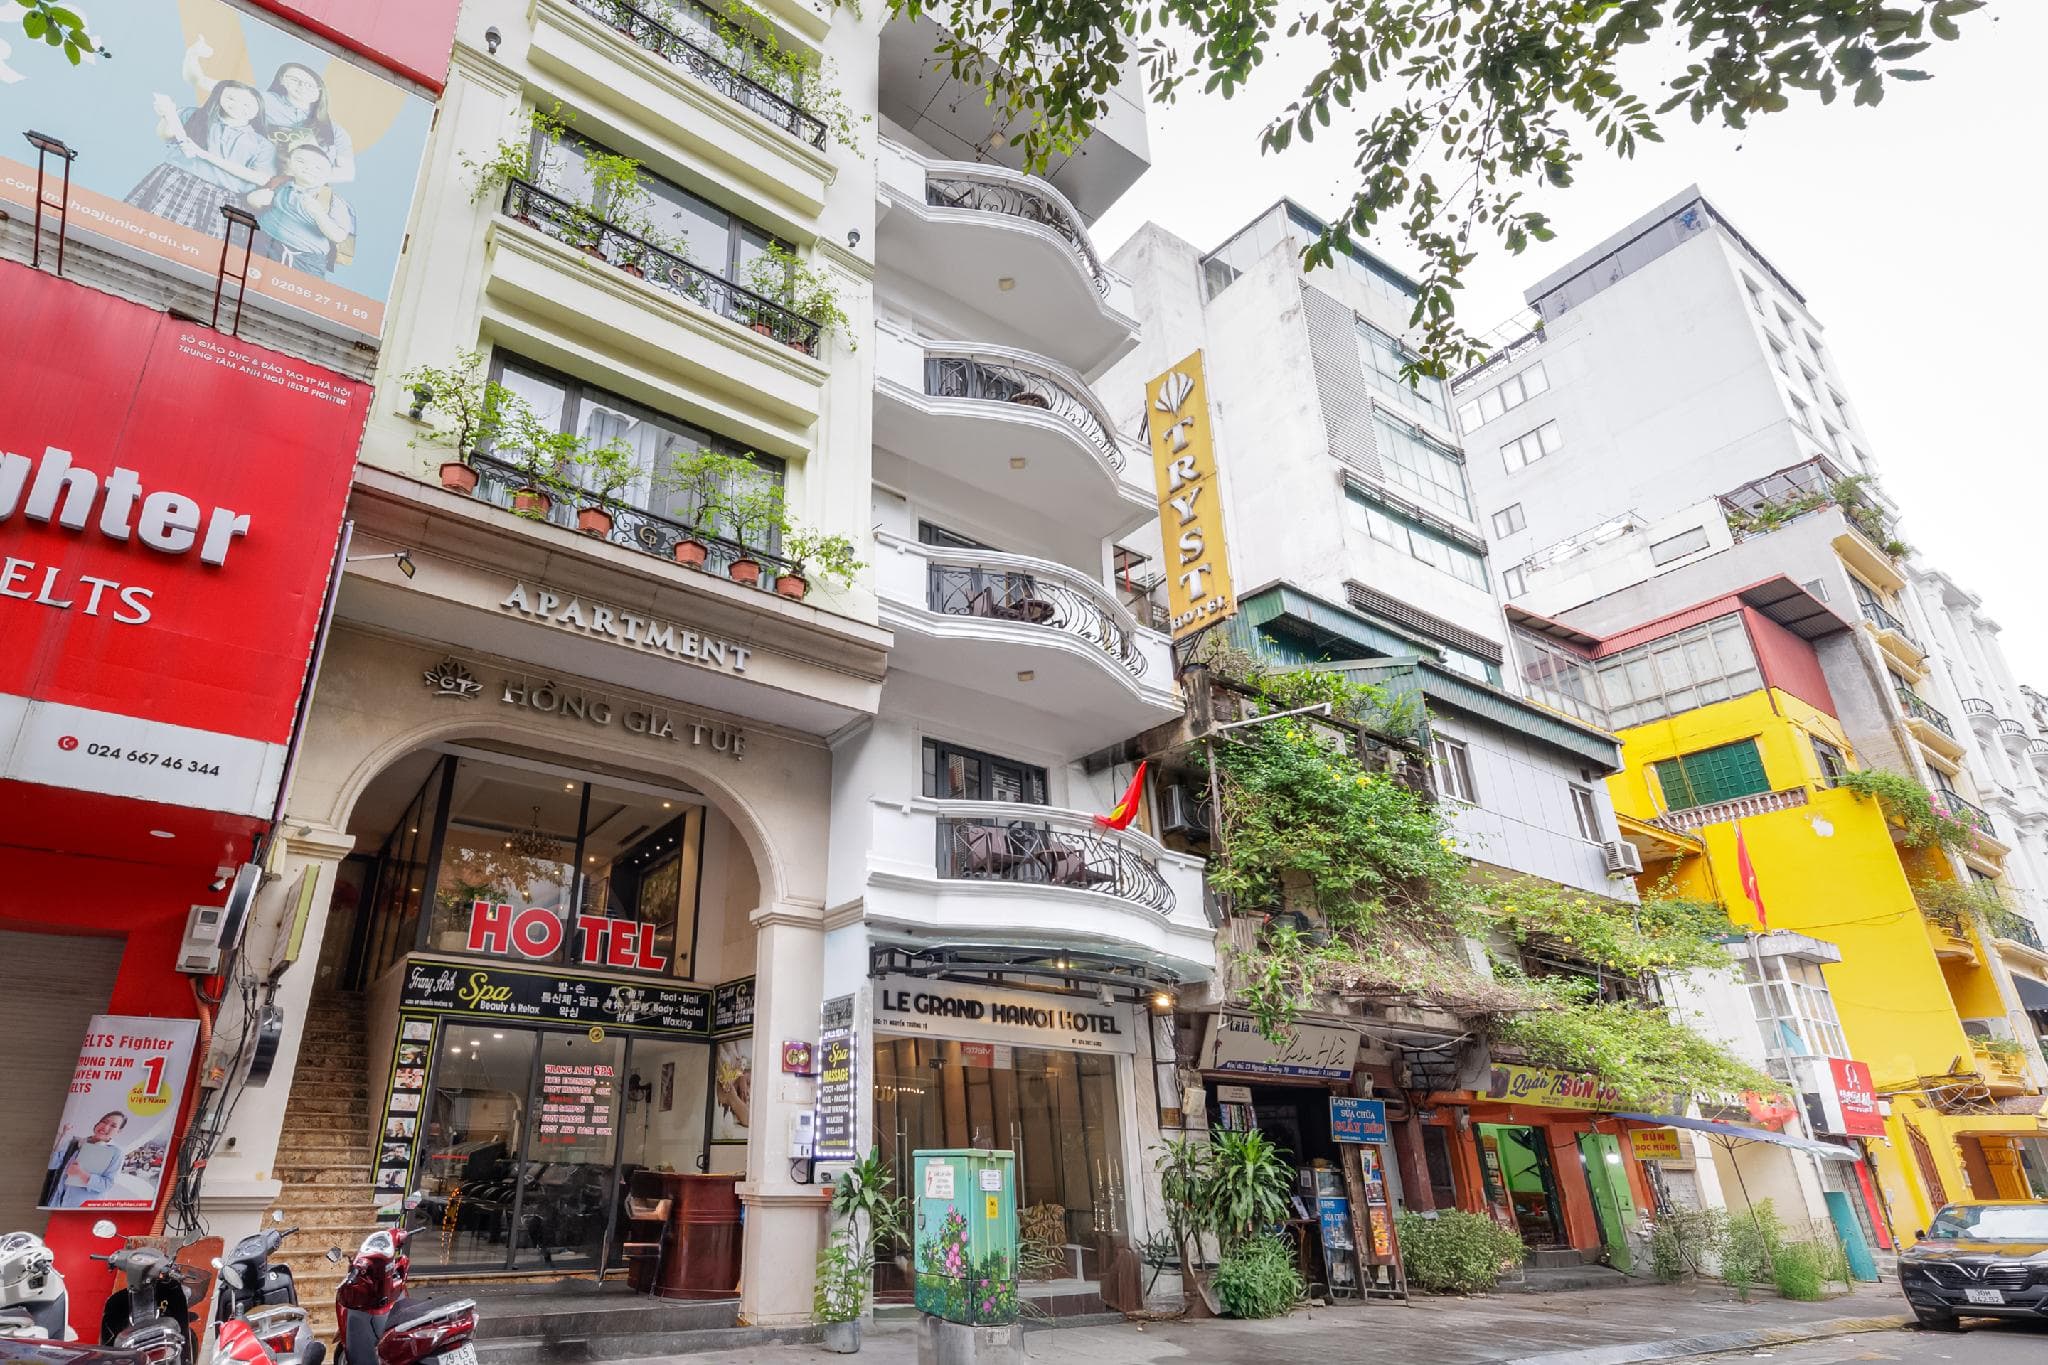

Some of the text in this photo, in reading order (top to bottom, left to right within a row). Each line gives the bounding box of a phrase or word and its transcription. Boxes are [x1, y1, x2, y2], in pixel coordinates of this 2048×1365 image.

[271, 277, 369, 320] 02036 27 11 69
[179, 345, 213, 361] TRUNG
[239, 365, 261, 378] ANH
[288, 381, 309, 393] IELTS
[311, 388, 347, 406] FIGHTER
[306, 376, 317, 385] TP
[1163, 416, 1211, 603] TRYST
[1172, 596, 1229, 631] HOTEL
[500, 583, 752, 672] APARTMENT
[502, 677, 613, 726] HỒNG
[623, 709, 681, 742] GIA
[87, 742, 220, 778] 024 667 46 344
[459, 972, 513, 1009] Spa
[480, 1000, 541, 1014] Beauty & Relax
[883, 990, 1121, 1034] LE GRAND HANOI HOTEL
[663, 1016, 693, 1029] Waxing
[119, 1036, 174, 1050] Fighter
[829, 1042, 849, 1068] Spa
[109, 1056, 134, 1067] TÂM
[594, 1064, 615, 1077] SPA
[104, 1071, 122, 1080] THI
[143, 1056, 165, 1094] 1
[823, 1068, 849, 1082] MASSAGE
[1333, 1099, 1358, 1107] LONG
[1642, 1131, 1665, 1141] BÚN
